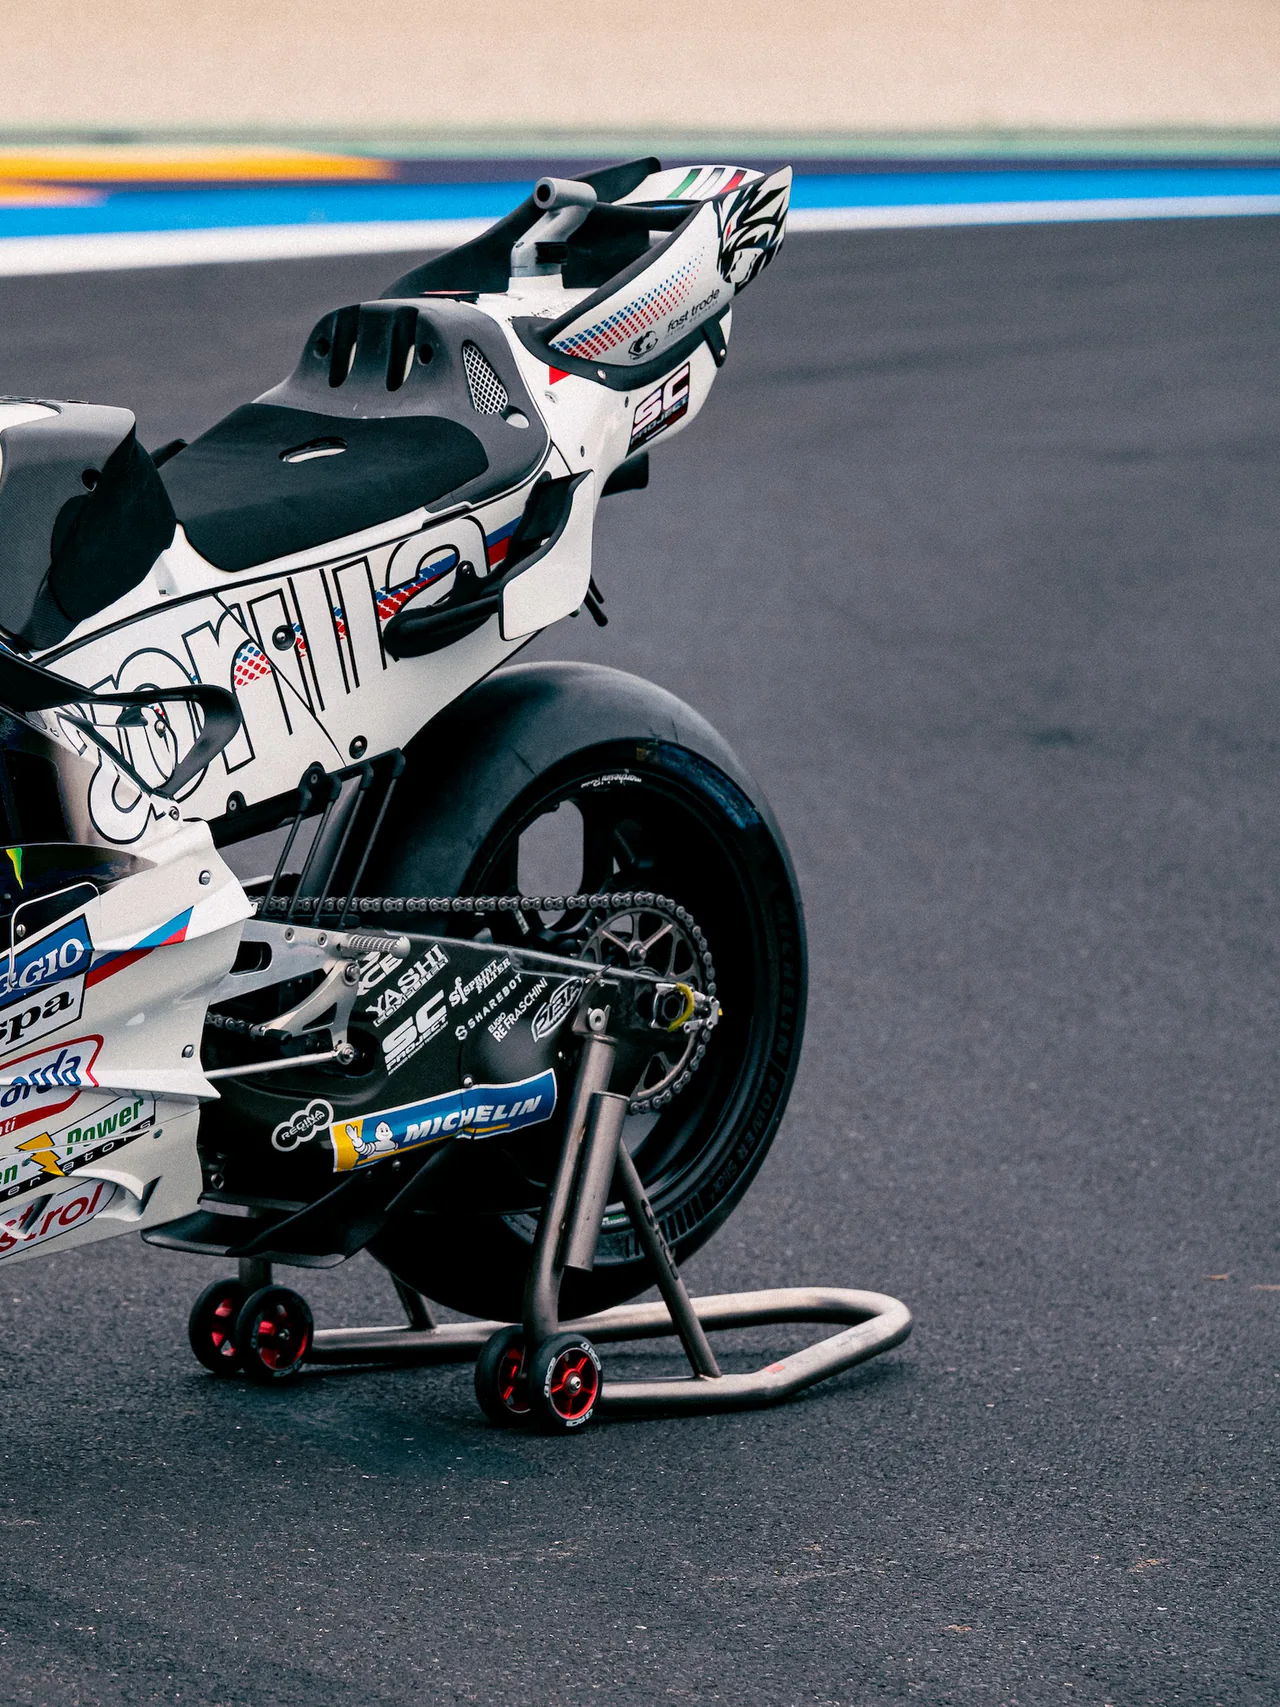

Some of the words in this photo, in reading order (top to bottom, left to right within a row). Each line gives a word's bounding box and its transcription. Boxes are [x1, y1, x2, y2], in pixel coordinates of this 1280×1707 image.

[632, 364, 689, 436] SC
[365, 944, 442, 1018] YASHI
[463, 959, 498, 996] SPRINT
[467, 973, 522, 1029] SHAREBOT
[475, 958, 511, 994] FILTER
[382, 990, 447, 1064] SC
[504, 977, 548, 1030] FRASCHINI
[66, 1095, 144, 1155] Power
[281, 1110, 325, 1140] REGINA
[403, 1095, 543, 1143] MICHELIN
